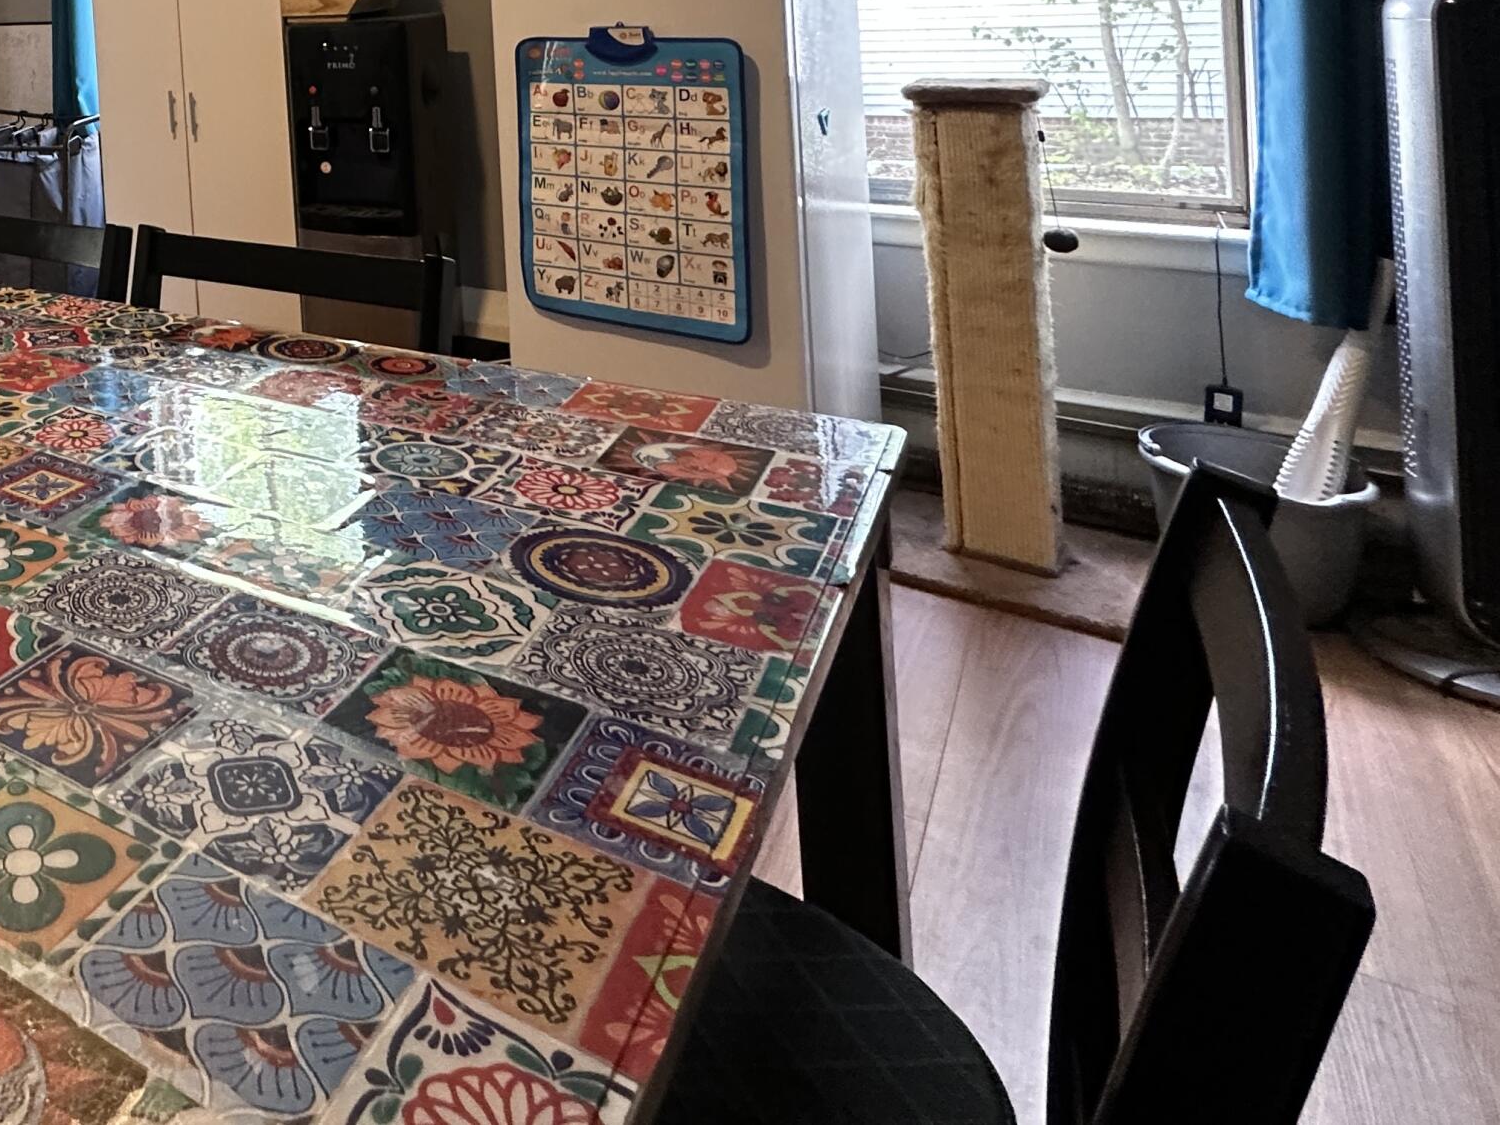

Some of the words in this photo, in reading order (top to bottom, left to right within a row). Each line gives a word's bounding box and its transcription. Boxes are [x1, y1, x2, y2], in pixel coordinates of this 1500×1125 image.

[577, 86, 593, 98] Bb
[679, 89, 697, 101] Dd
[579, 117, 593, 129] Ff
[680, 123, 697, 135] Hh
[580, 150, 592, 163] Jj
[628, 153, 644, 165] Kk
[535, 178, 554, 188] Mm
[581, 181, 597, 193] Nn
[629, 186, 645, 197] Oo
[681, 190, 697, 204] Pp
[535, 208, 550, 221] Qq
[629, 218, 645, 231] Ss
[682, 223, 696, 236] Tt
[536, 238, 551, 250] Uu
[583, 244, 598, 257] Vv
[537, 269, 551, 283] Yy
